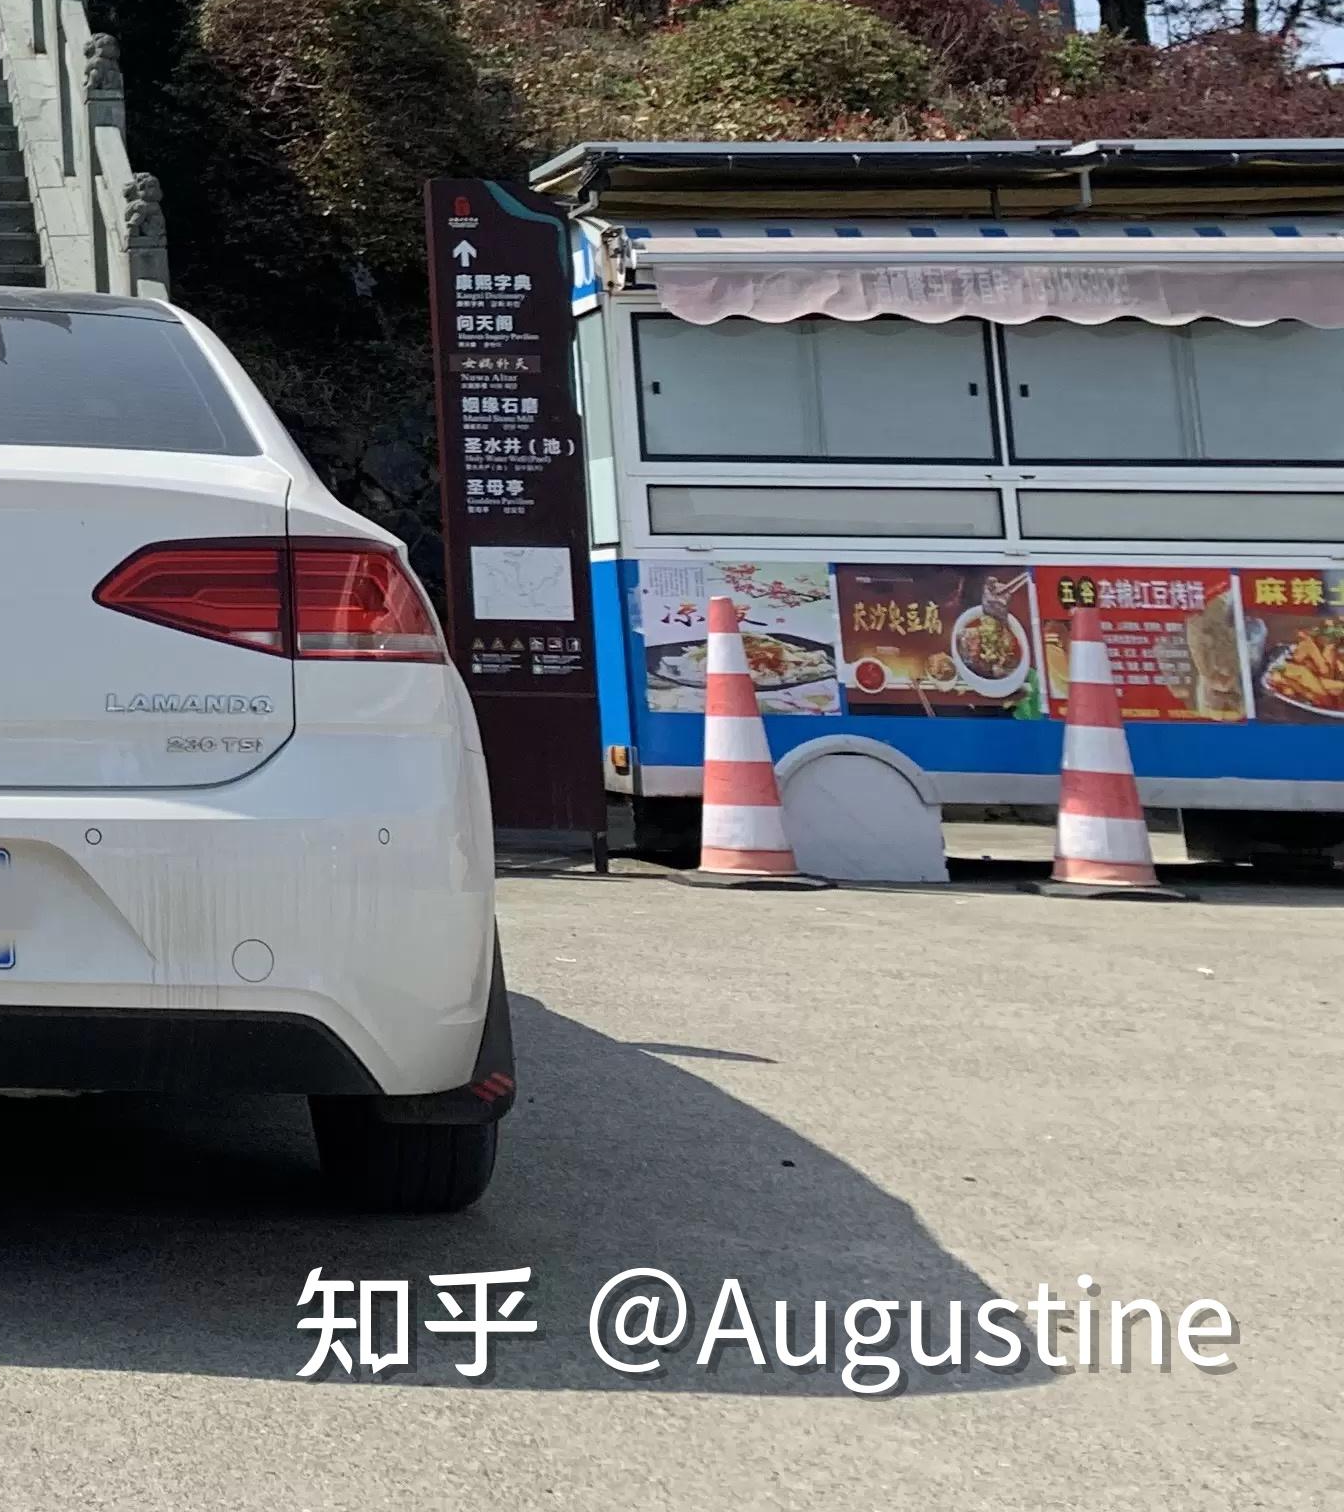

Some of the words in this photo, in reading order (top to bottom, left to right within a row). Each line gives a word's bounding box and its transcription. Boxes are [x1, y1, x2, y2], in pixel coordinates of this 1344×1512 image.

[456, 274, 532, 291] 康熙字典
[457, 315, 513, 332] 问天阁
[462, 396, 539, 414] 姻缘石磨
[467, 479, 525, 496] 圣母亭
[103, 693, 276, 715] LAMANDO
[166, 736, 217, 753] 230
